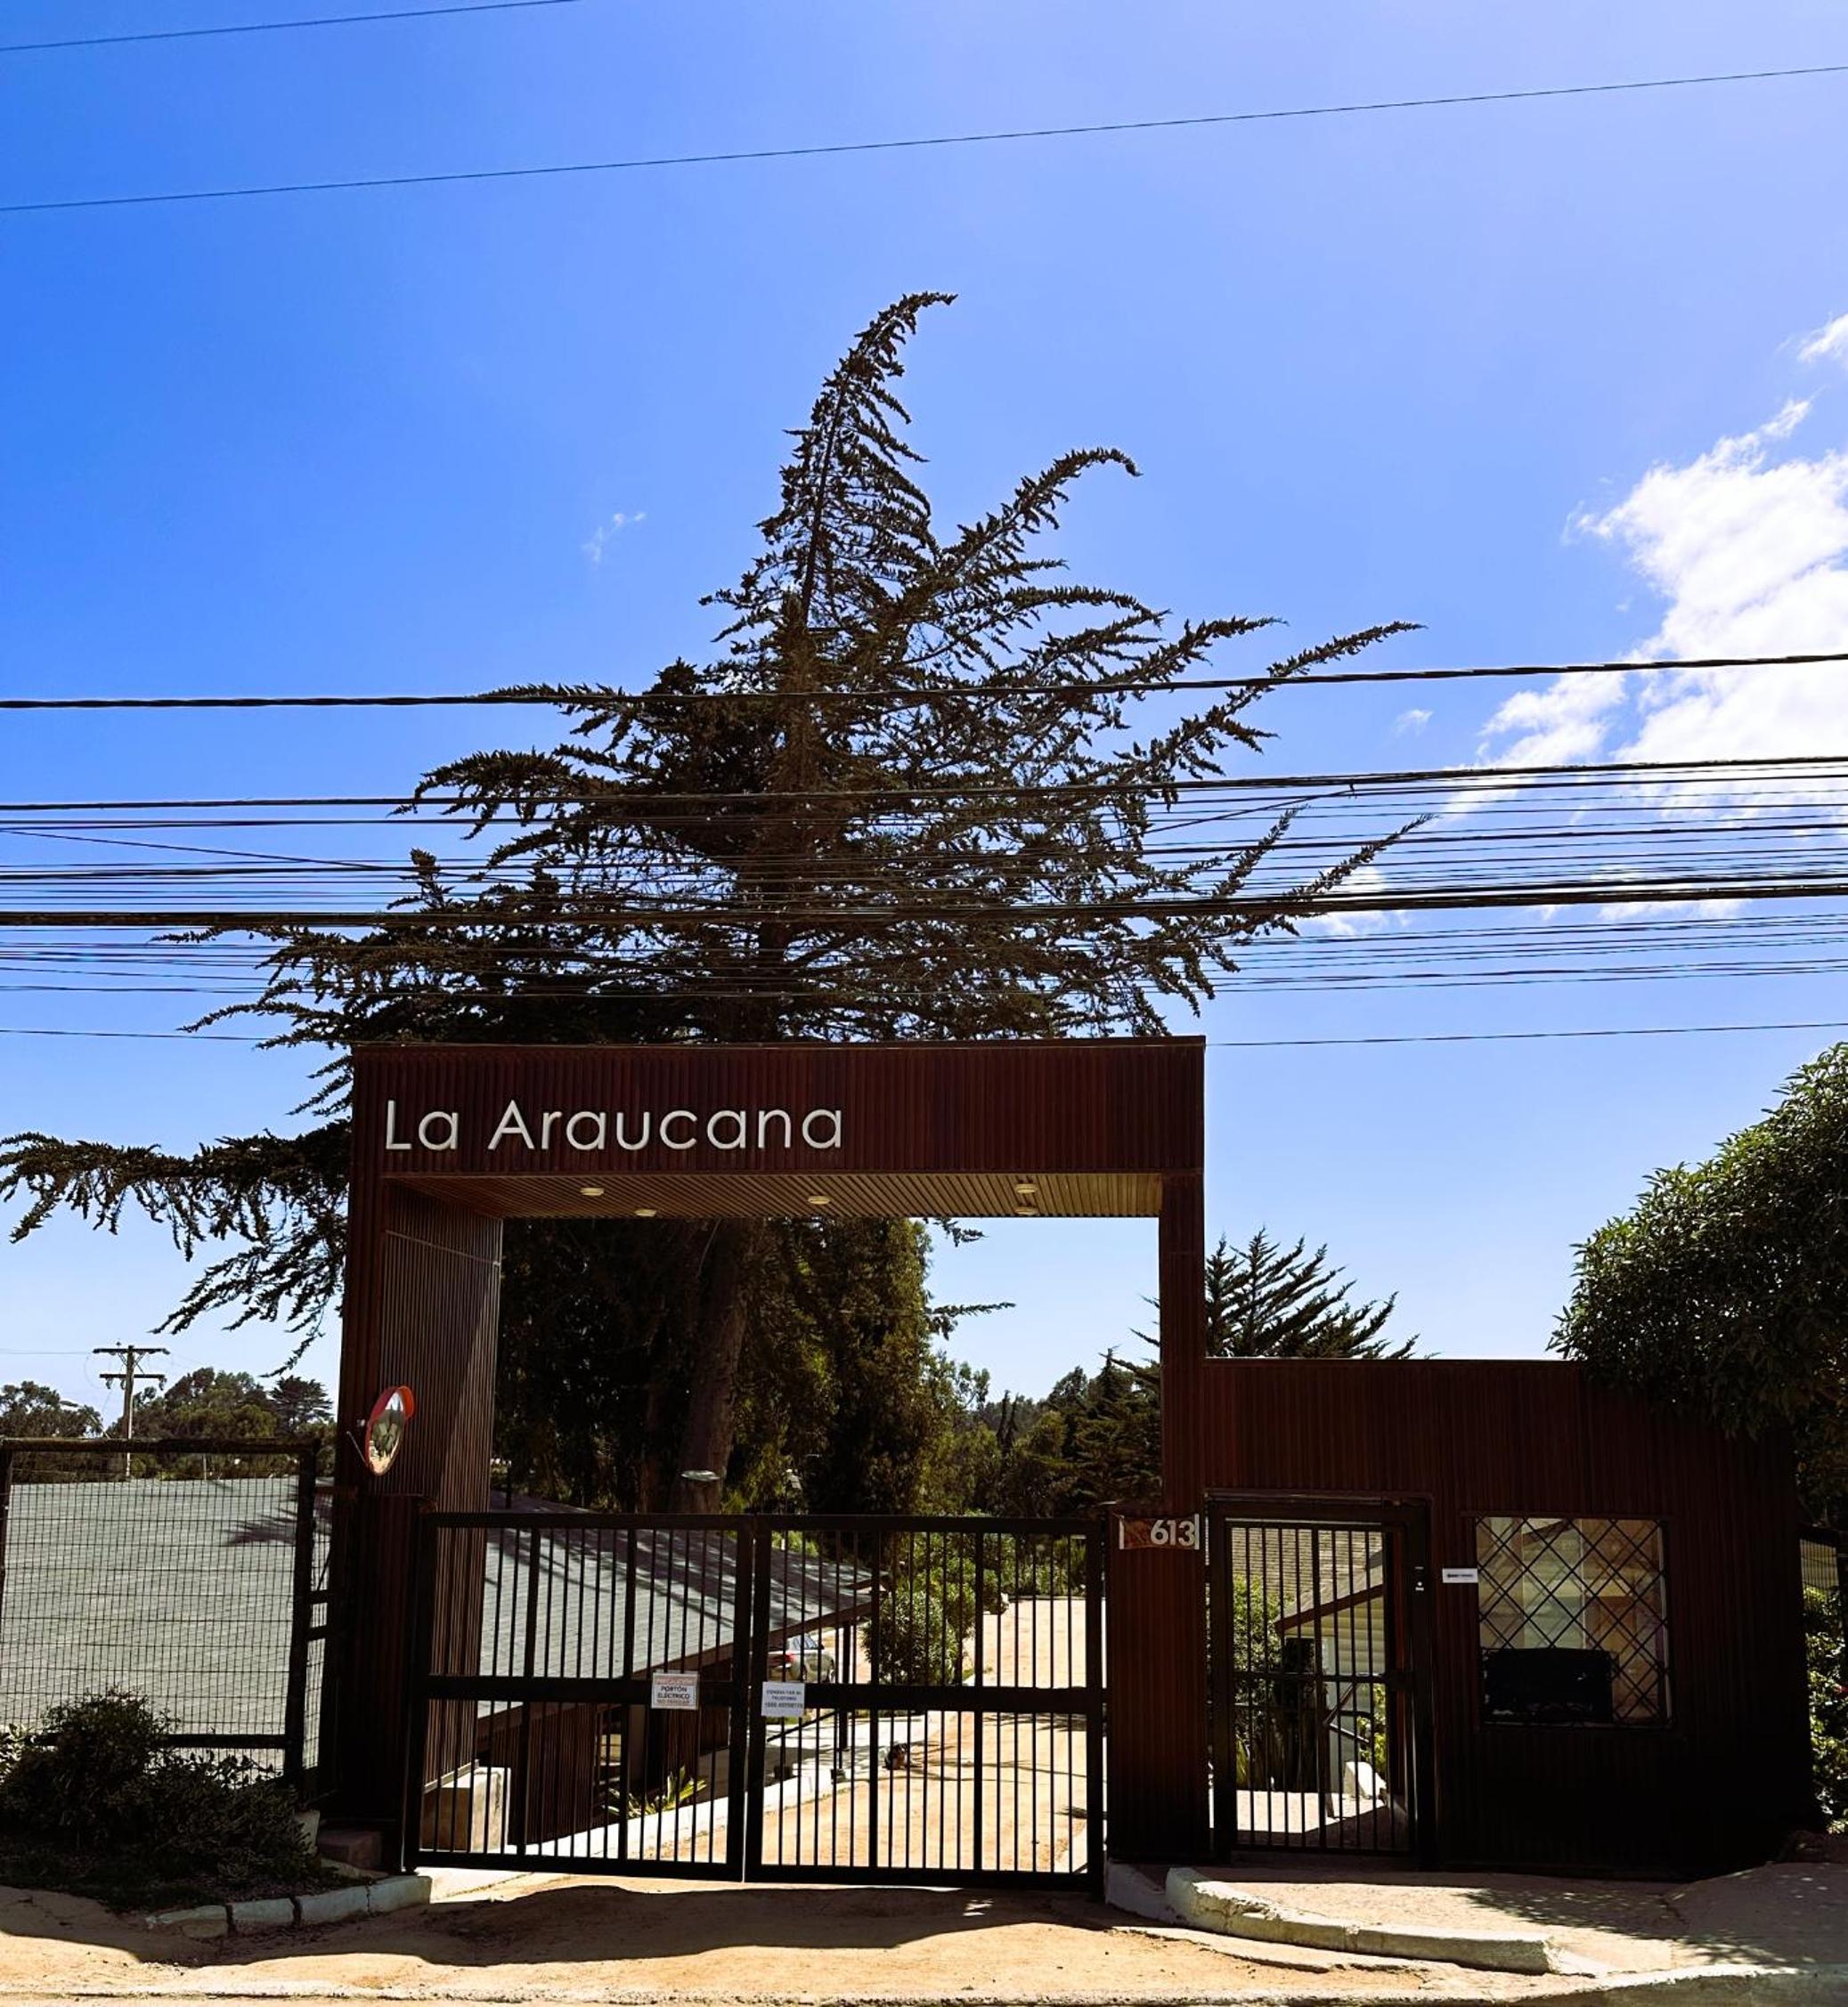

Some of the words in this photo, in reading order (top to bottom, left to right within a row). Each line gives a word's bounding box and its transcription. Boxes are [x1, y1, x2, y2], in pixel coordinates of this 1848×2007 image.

[386, 1100, 459, 1150] La
[487, 1100, 843, 1150] Araucana
[1150, 1519, 1195, 1547] 613
